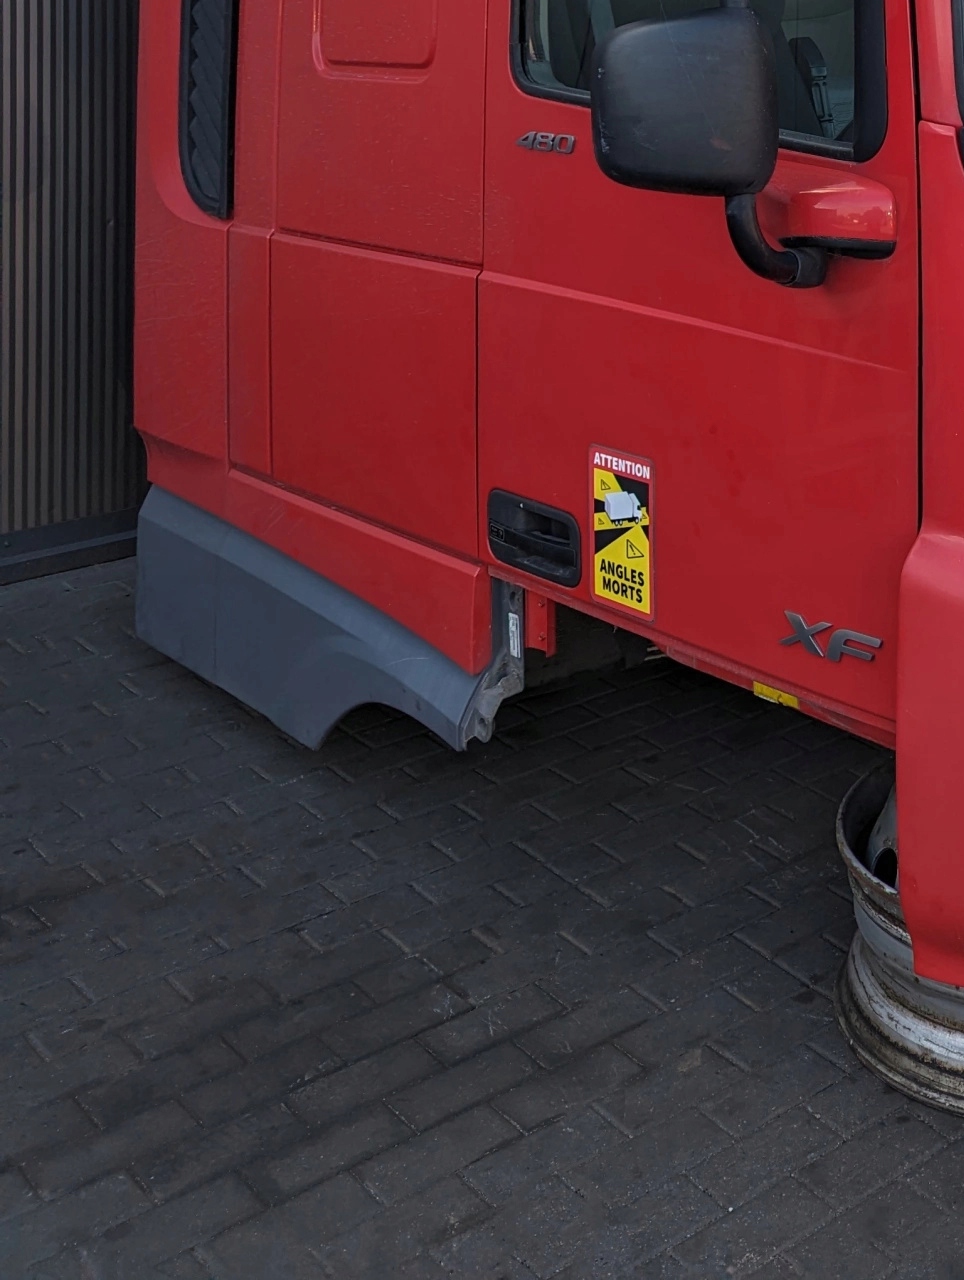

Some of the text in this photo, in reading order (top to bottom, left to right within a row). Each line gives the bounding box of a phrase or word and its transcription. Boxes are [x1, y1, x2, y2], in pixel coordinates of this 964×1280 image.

[516, 131, 575, 153] 480
[594, 452, 650, 480] ATTENTION
[600, 558, 644, 587] ANGLES
[602, 576, 643, 604] MORTS
[778, 610, 883, 663] XF
